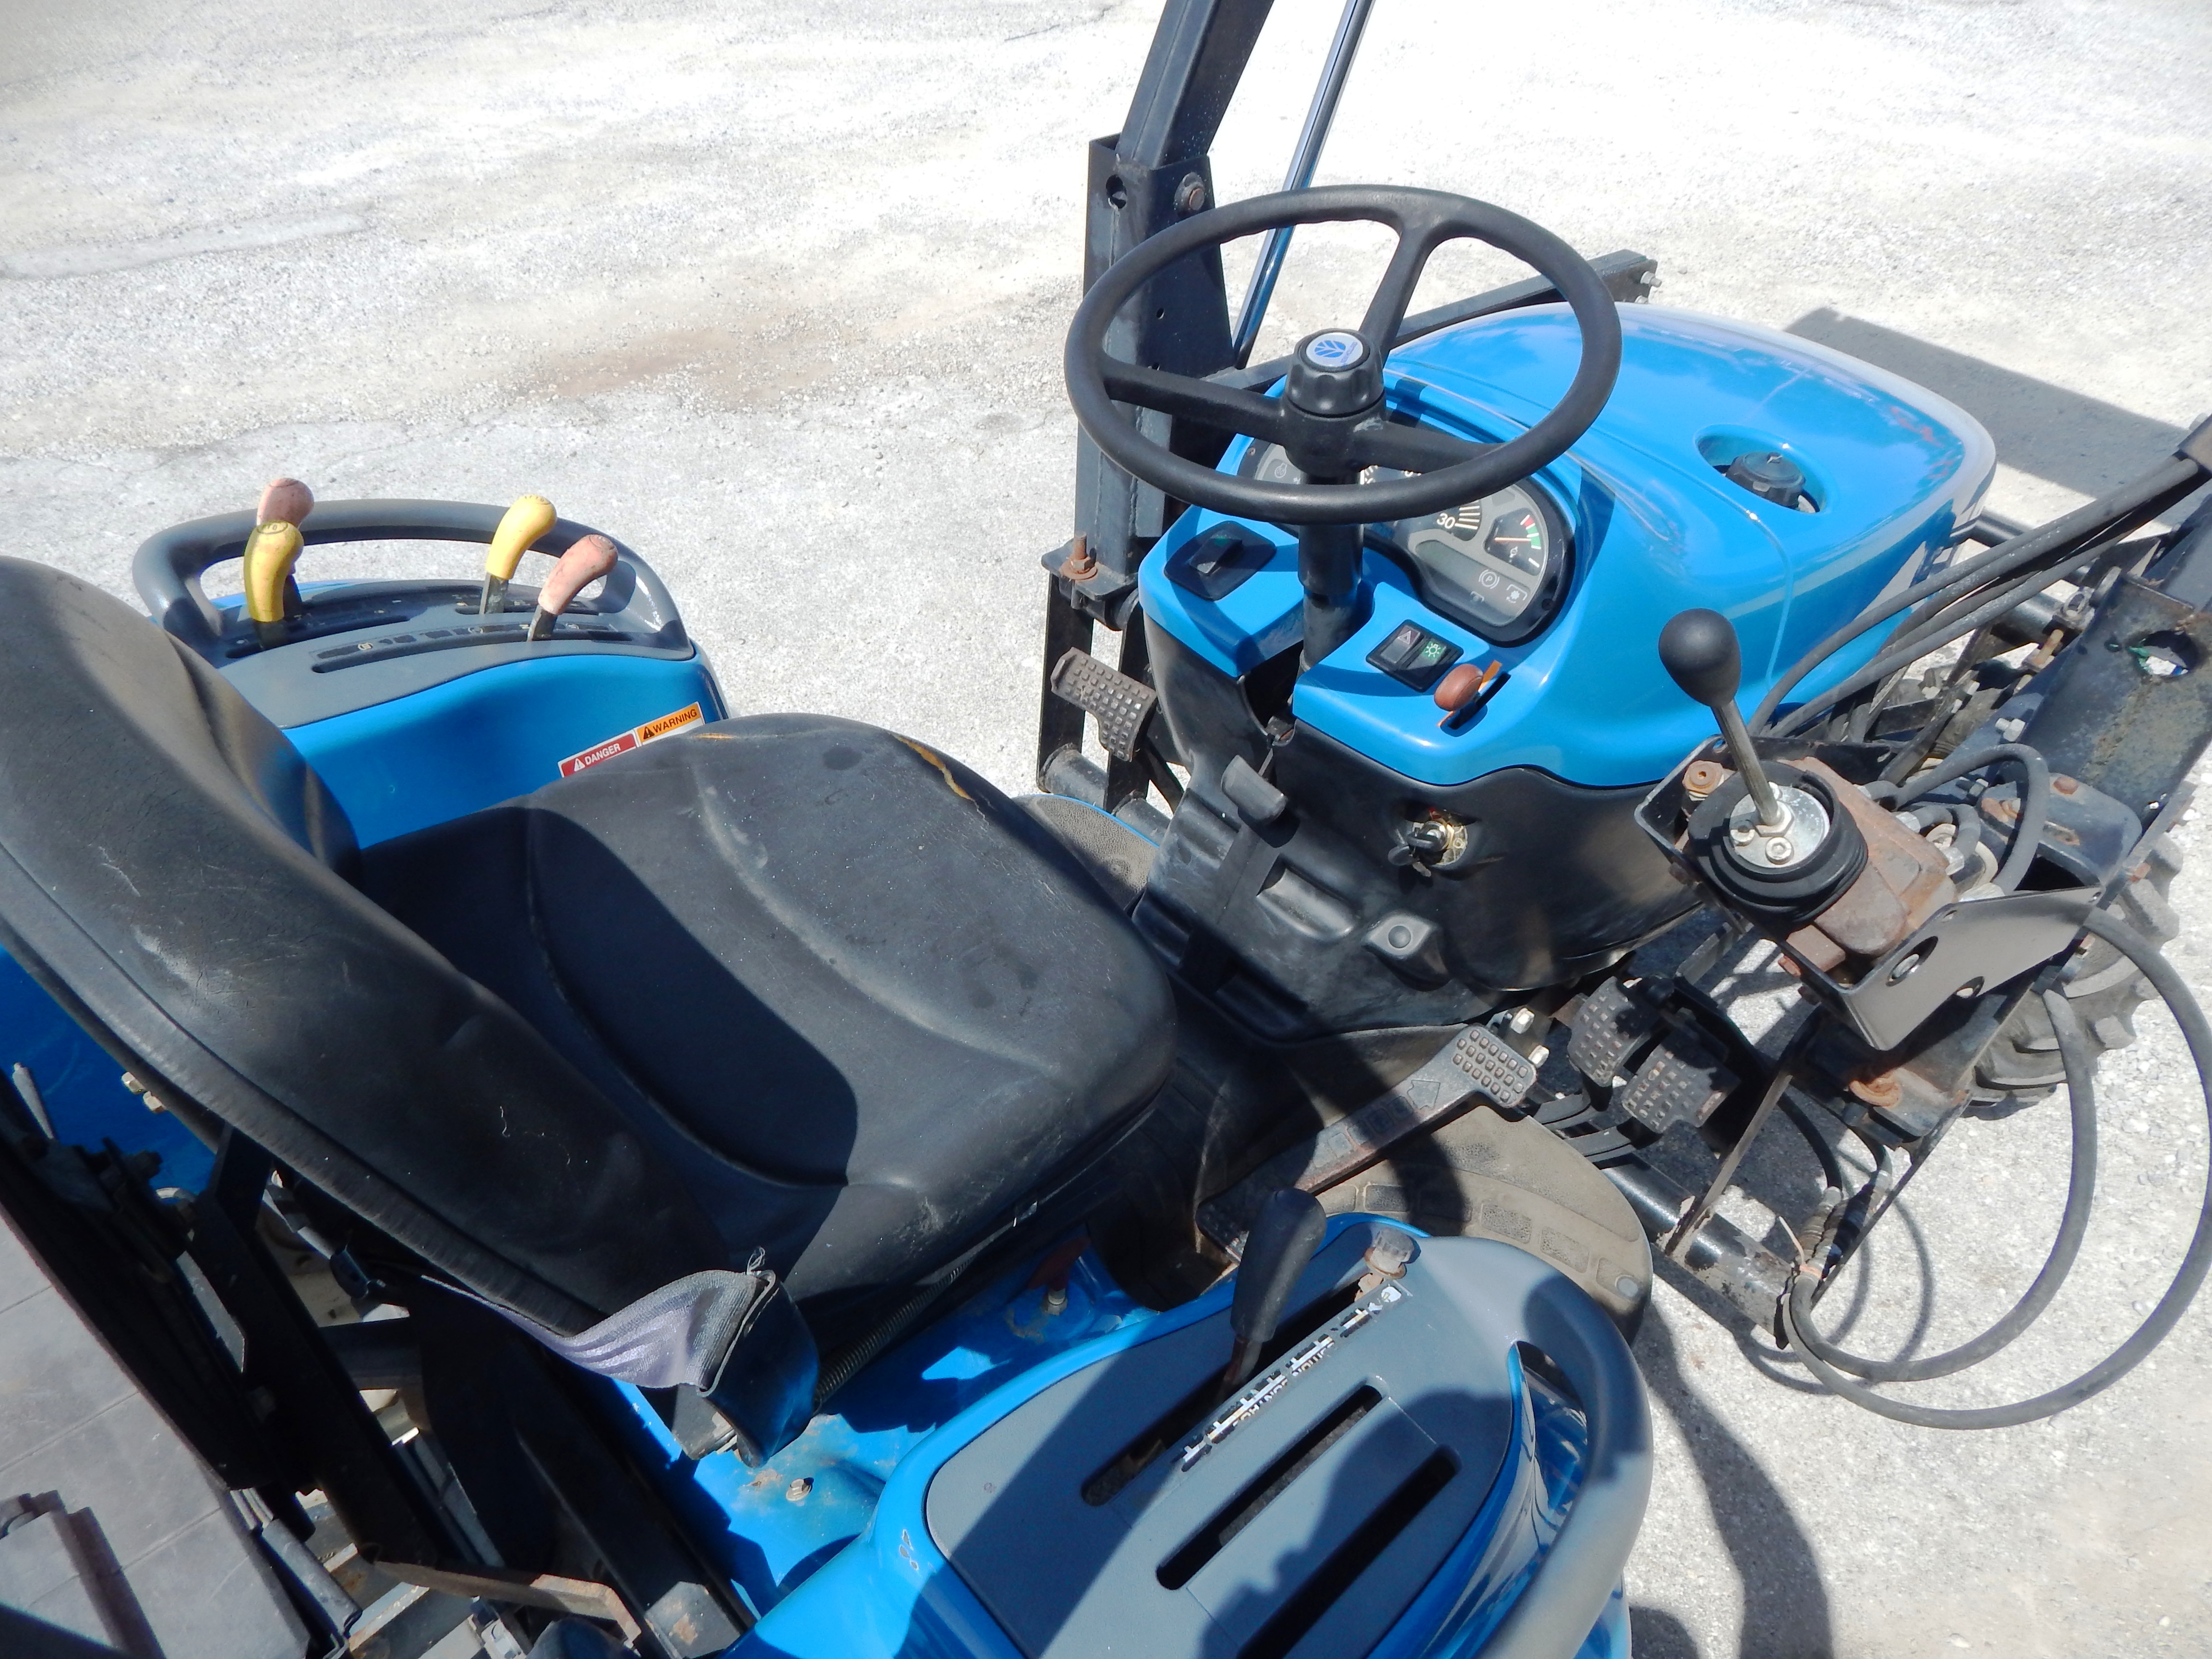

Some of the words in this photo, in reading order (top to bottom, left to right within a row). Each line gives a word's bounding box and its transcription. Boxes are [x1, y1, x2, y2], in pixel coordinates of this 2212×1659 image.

[1437, 513, 1455, 529] 30
[653, 709, 697, 733] WARNING
[585, 743, 621, 765] DANGER
